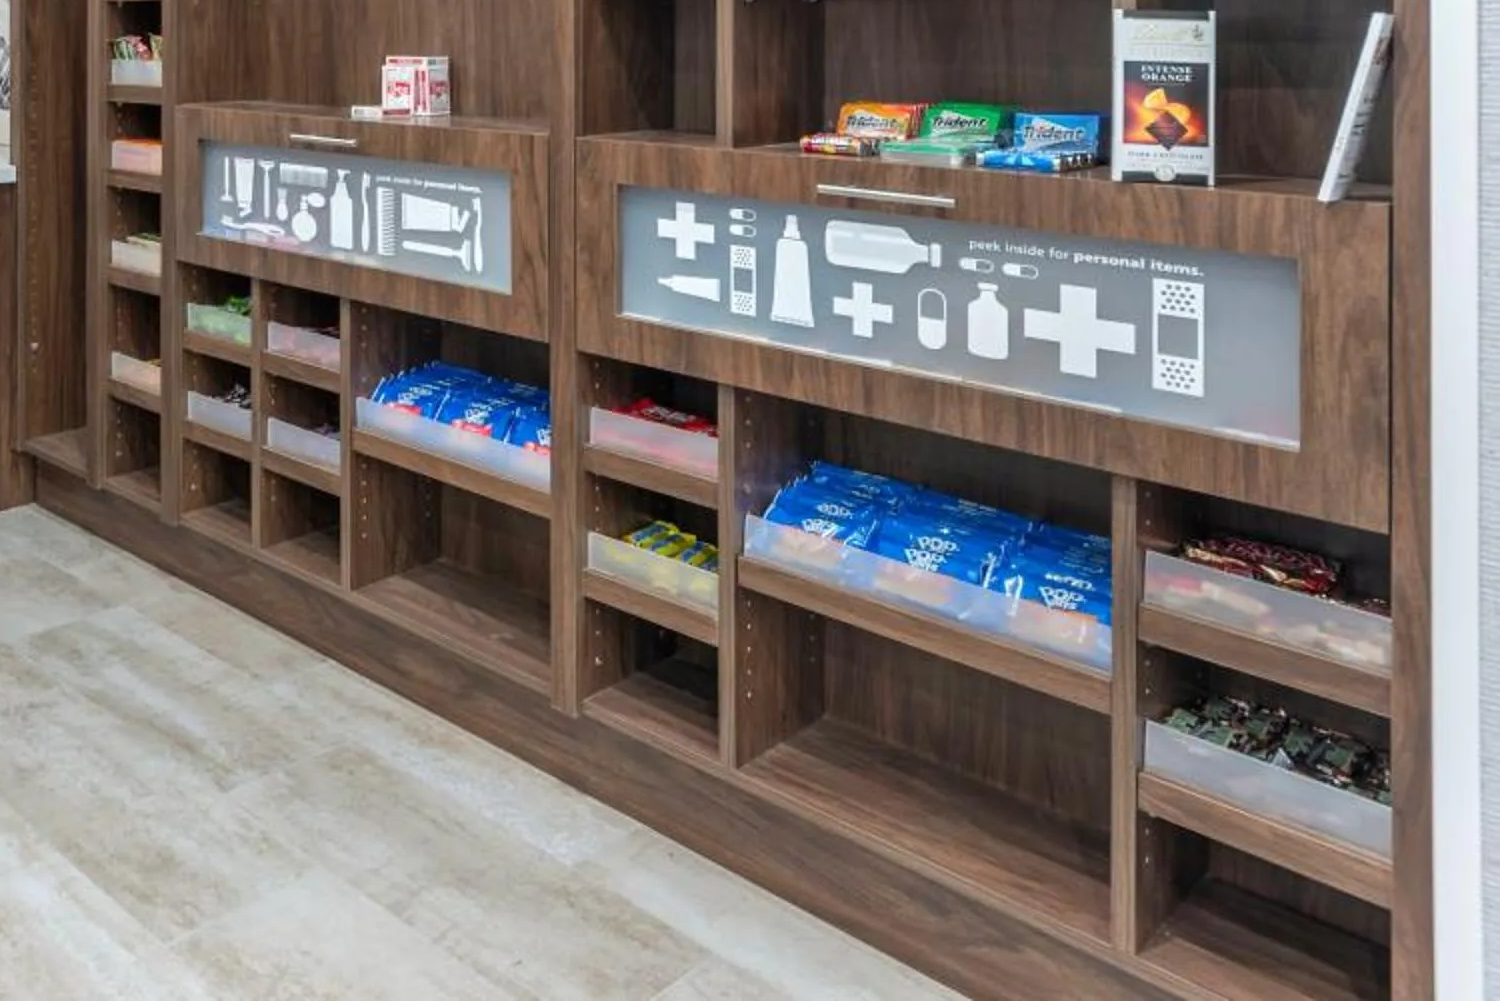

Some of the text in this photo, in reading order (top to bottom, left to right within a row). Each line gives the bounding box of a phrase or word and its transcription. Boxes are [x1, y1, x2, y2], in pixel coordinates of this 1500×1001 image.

[1141, 65, 1192, 74] INTENSE
[1141, 72, 1192, 83] ORANGE
[932, 115, 988, 129] Trident
[1022, 125, 1085, 143] Trident
[969, 240, 1204, 277] peek inside for personal items.
